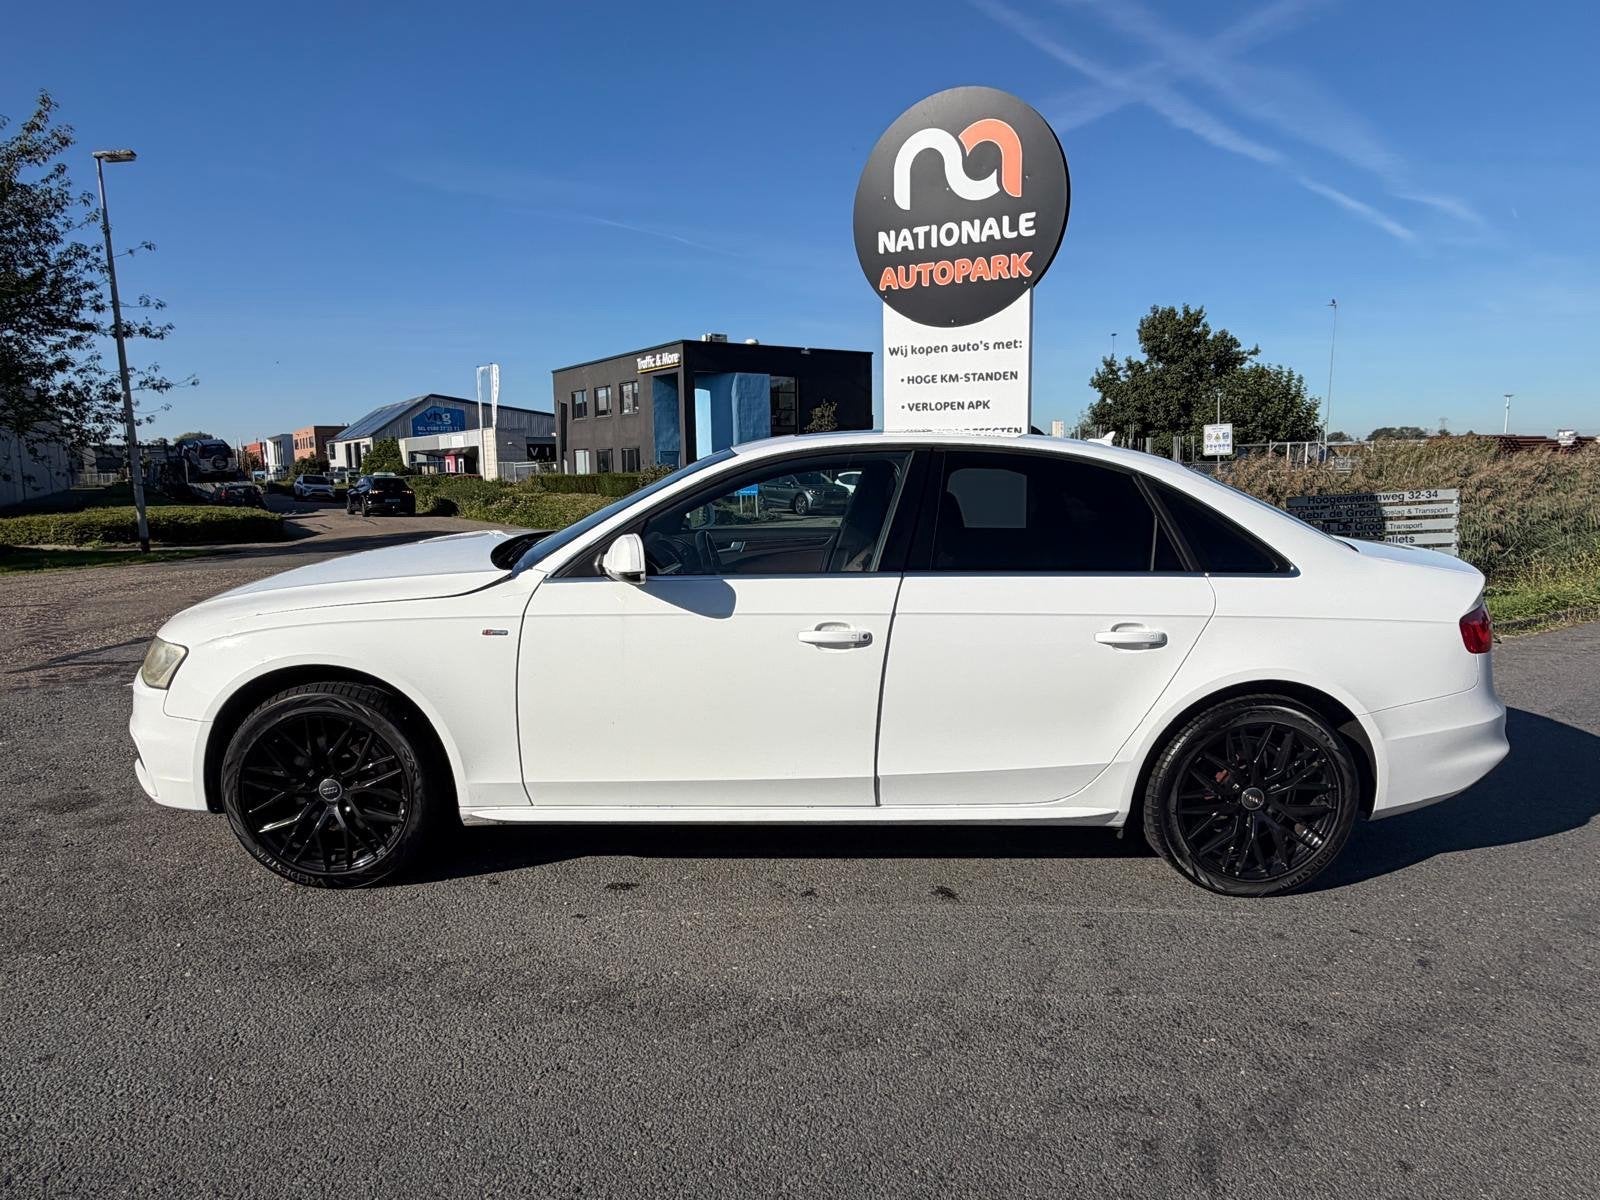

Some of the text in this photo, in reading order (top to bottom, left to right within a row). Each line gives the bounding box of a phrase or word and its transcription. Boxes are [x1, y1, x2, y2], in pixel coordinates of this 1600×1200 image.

[878, 212, 1036, 254] NATIONALE
[879, 251, 1034, 291] AUTOPARK
[888, 339, 1023, 358] Wij kopen auto's met:
[907, 370, 1019, 385] HOGE KM-STANDEN
[907, 400, 991, 412] VERLOPEN APK
[1407, 490, 1439, 500] 32-34
[1329, 508, 1343, 518] de
[1345, 507, 1378, 518] Groot
[1415, 506, 1449, 516] Transport
[1389, 522, 1423, 531] Transport
